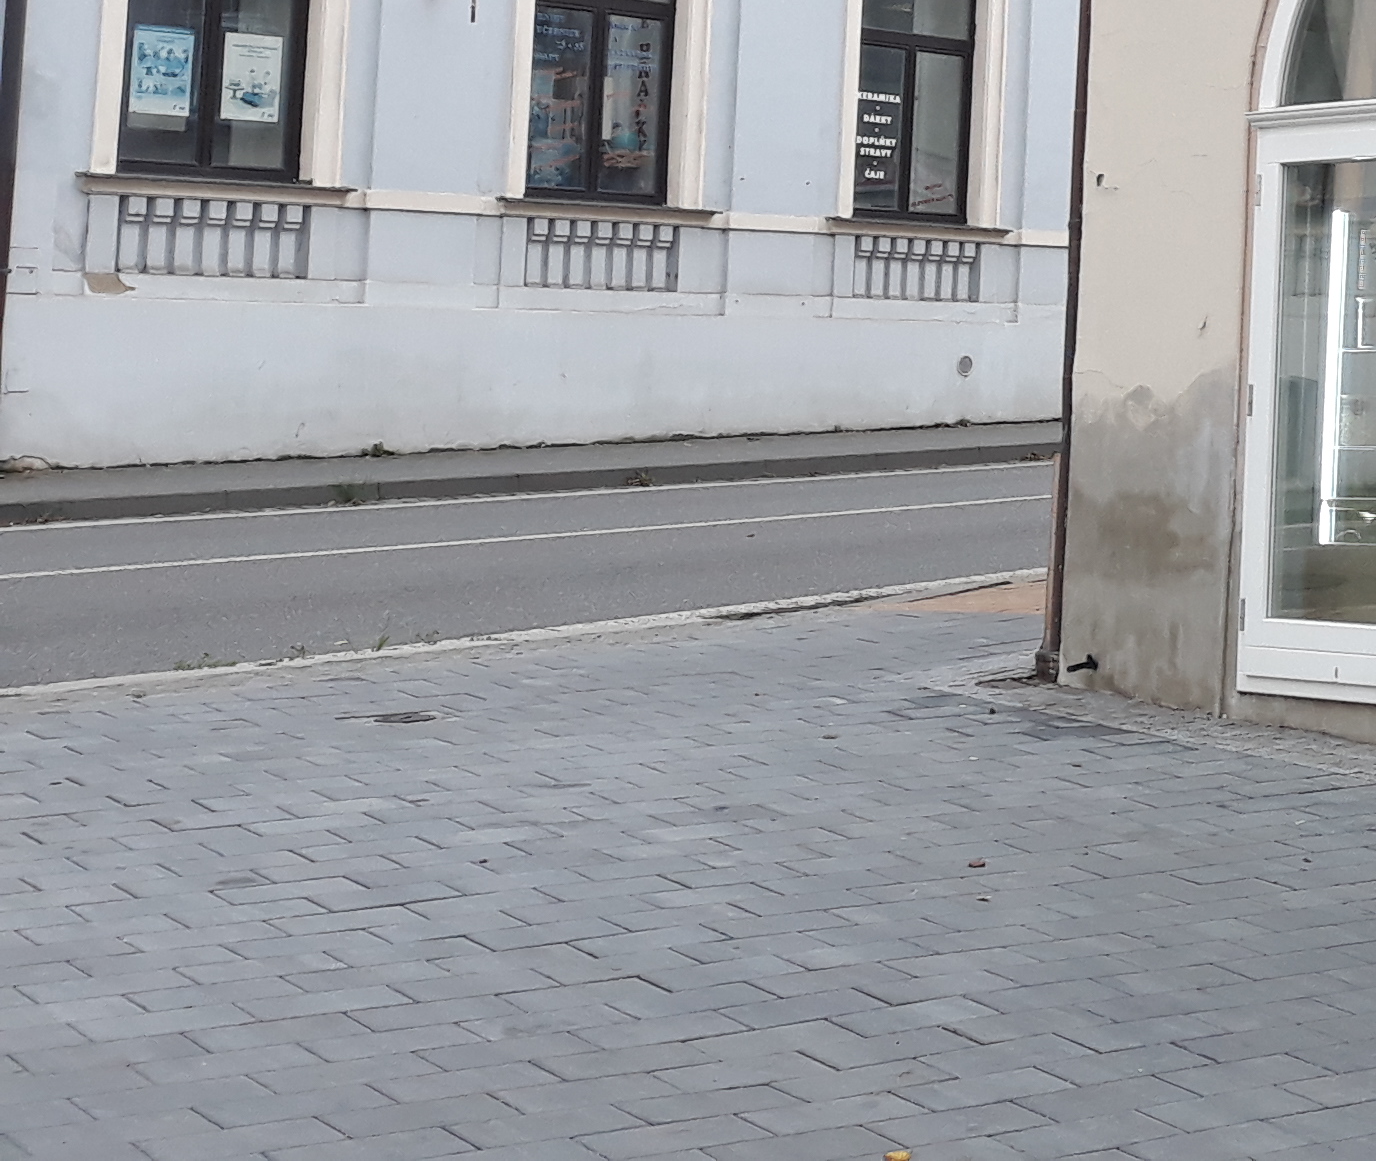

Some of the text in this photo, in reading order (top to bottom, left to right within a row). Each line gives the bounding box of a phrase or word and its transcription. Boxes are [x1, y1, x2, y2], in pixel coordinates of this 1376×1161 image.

[863, 113, 893, 125] DÁRKY
[859, 147, 893, 158] STRAVY
[864, 167, 885, 180] ČAJE
